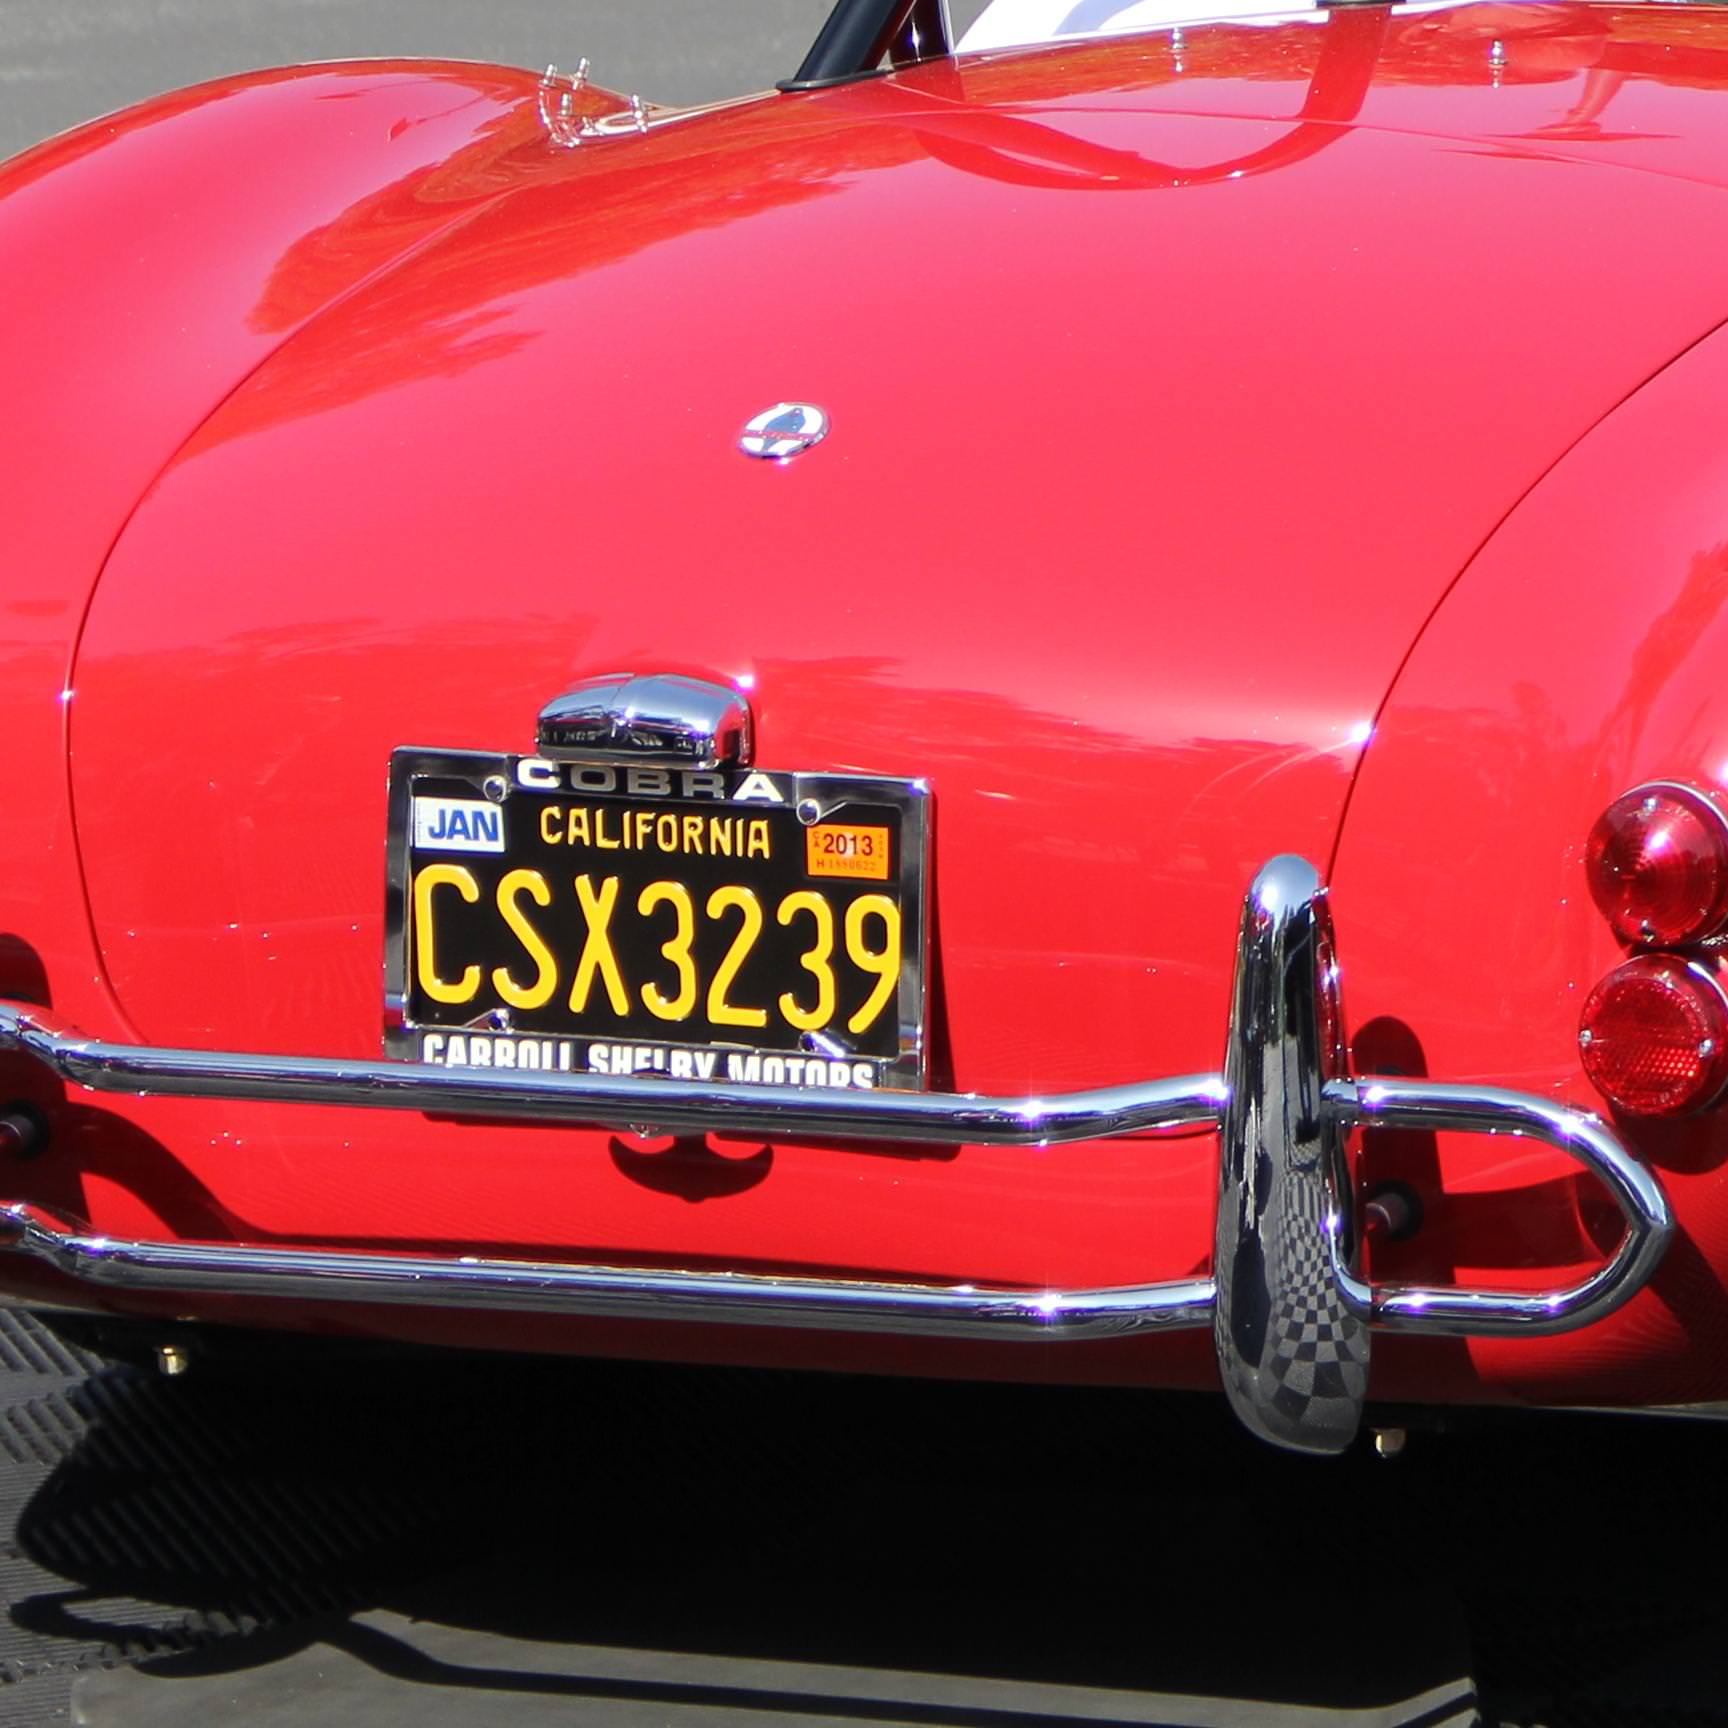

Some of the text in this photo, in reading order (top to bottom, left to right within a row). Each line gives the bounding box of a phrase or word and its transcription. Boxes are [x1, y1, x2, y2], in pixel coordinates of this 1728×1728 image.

[517, 758, 784, 802] COBRA
[427, 808, 499, 842] JAN
[540, 805, 770, 860] CALIFORNIA
[823, 832, 873, 857] 2013
[414, 864, 900, 1034] CSX3239
